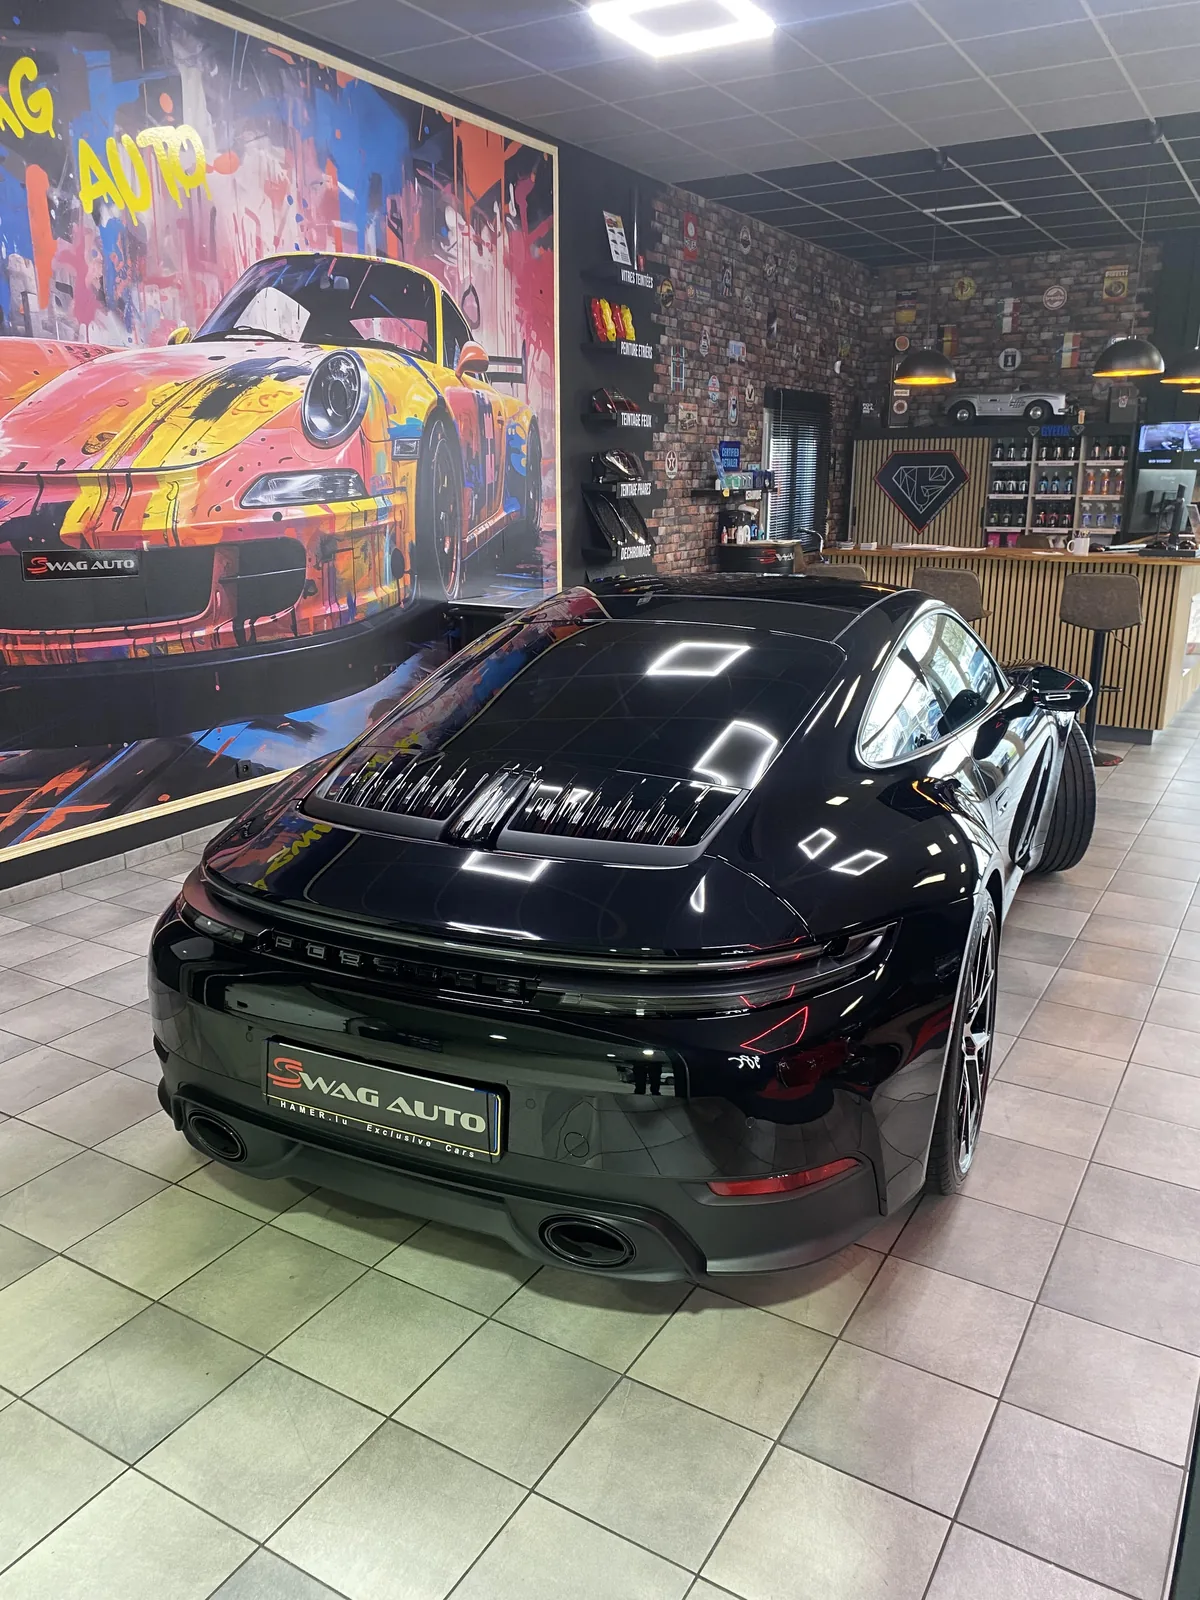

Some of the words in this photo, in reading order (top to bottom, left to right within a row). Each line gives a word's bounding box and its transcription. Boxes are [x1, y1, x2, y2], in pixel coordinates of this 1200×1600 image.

[78, 124, 212, 226] AUTO
[621, 269, 635, 284] VITRES
[620, 341, 638, 357] PEINTURE
[621, 412, 641, 426] TEINTAGE
[641, 413, 652, 428] FEUX
[721, 447, 740, 457] CERTIFIED
[721, 458, 738, 468] DETAILER
[621, 483, 637, 497] TEINTAGE
[637, 482, 652, 496] PHARES
[621, 544, 652, 560] DECHROMAGE
[27, 556, 88, 574] SWAG
[90, 559, 135, 570] AUTO
[267, 1057, 379, 1108] SWAG
[386, 1096, 487, 1134] AUTO
[366, 1124, 432, 1148] Exclusive
[445, 1144, 475, 1158] Cars
